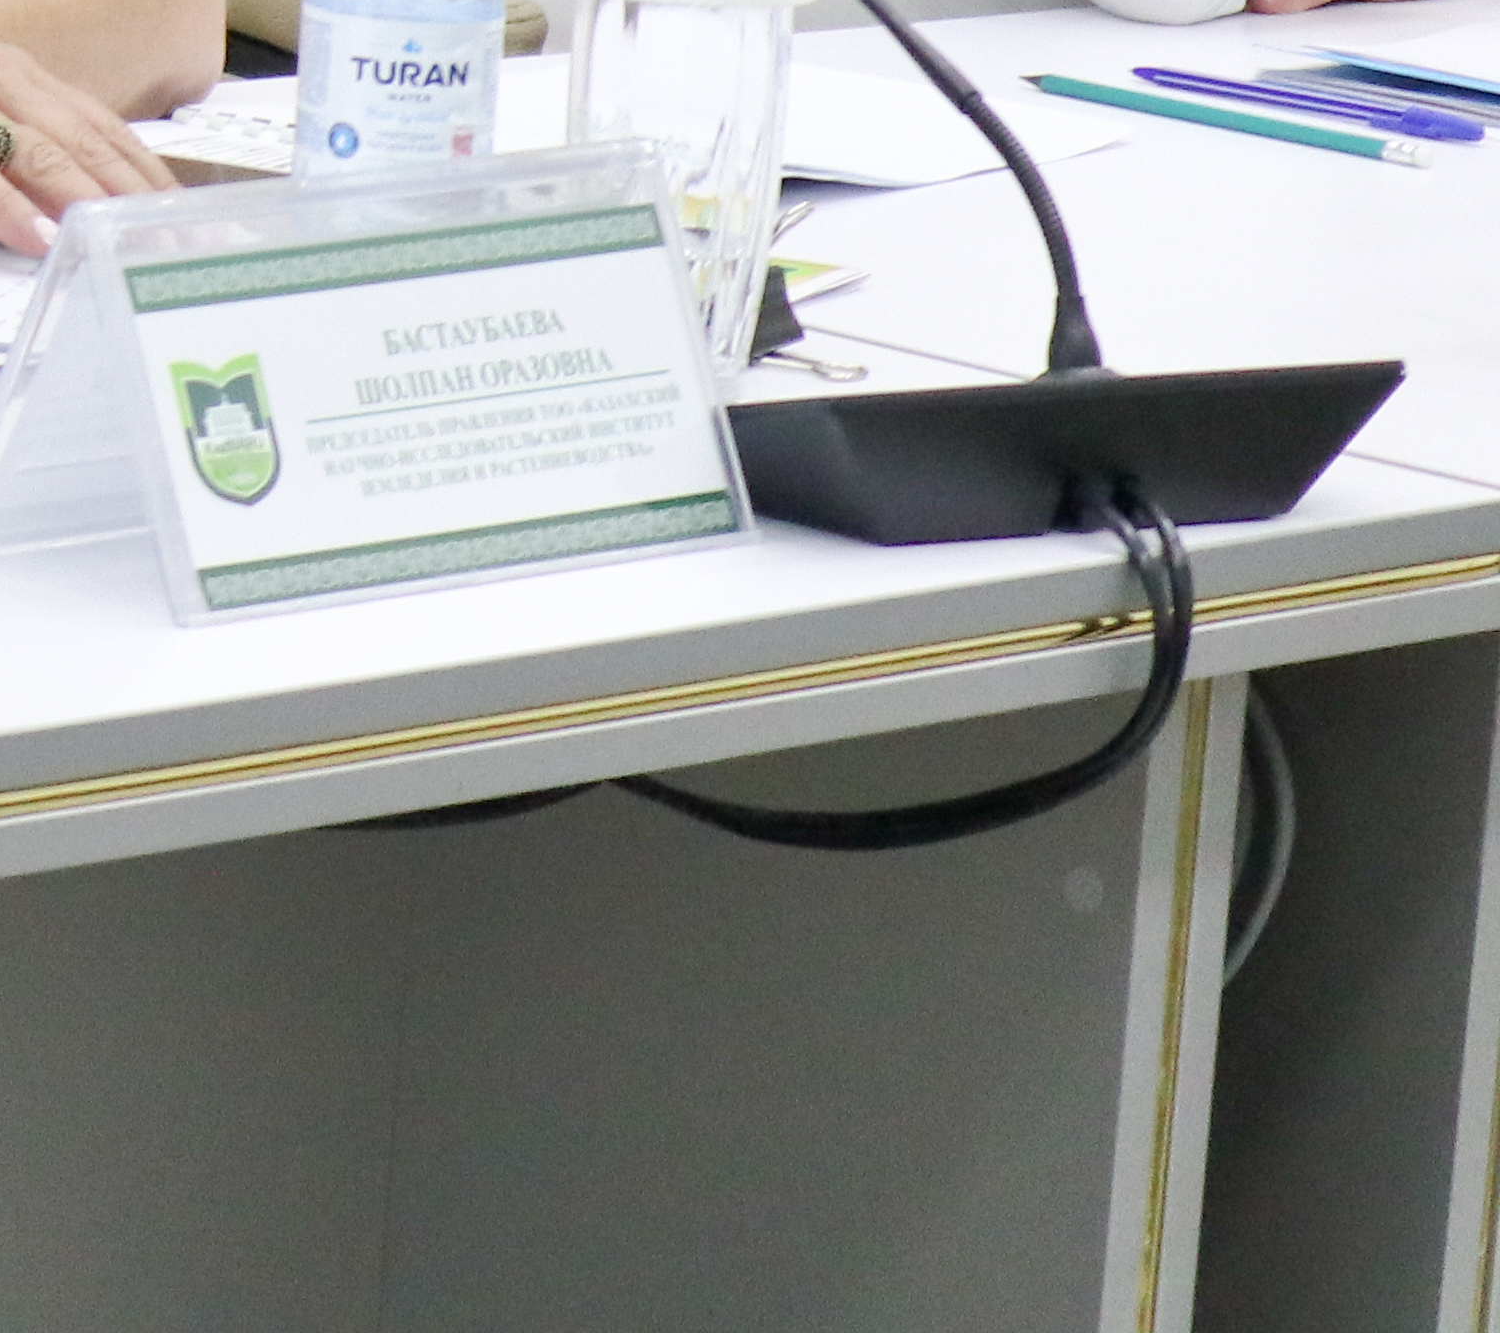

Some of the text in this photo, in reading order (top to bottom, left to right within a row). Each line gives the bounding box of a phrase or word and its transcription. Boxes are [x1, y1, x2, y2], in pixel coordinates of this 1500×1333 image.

[351, 57, 470, 87] TURAN
[381, 307, 566, 356] БАСТАУБАЕВА
[354, 346, 614, 407] ШОЛПАН ОРАЗОВНА
